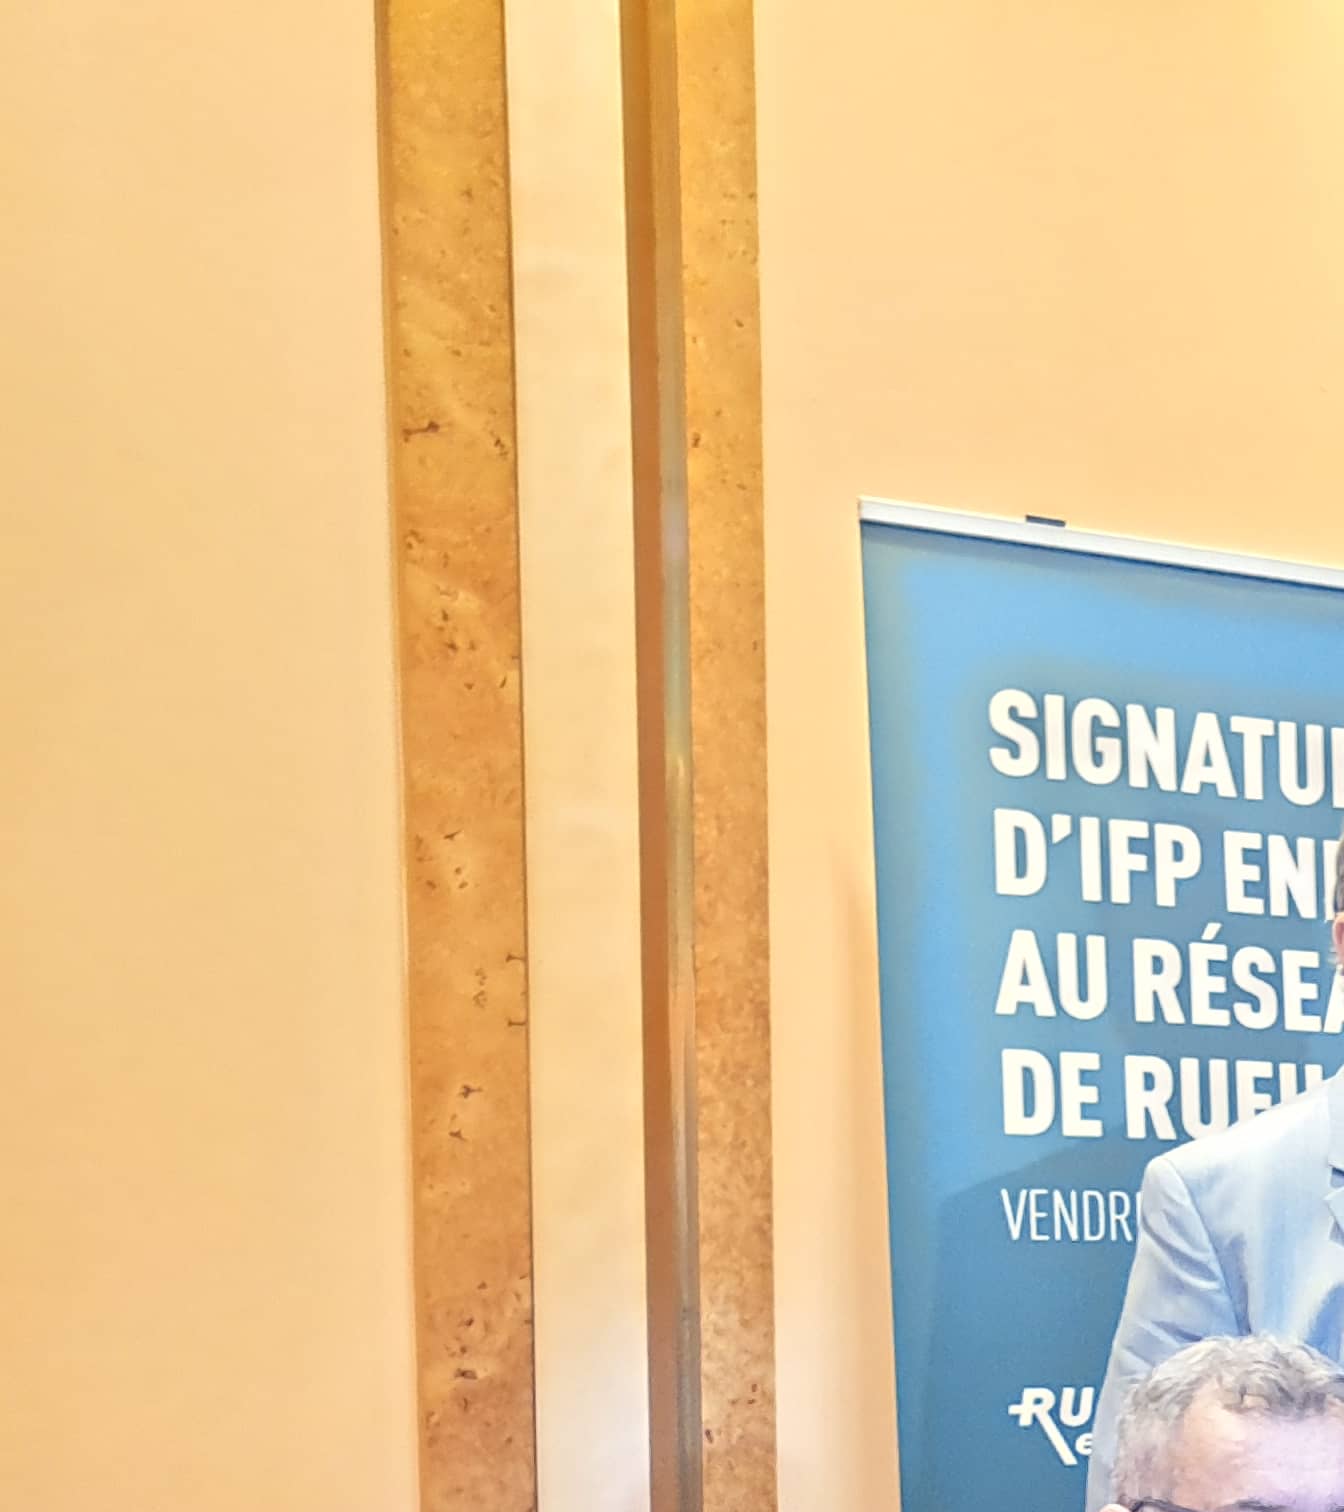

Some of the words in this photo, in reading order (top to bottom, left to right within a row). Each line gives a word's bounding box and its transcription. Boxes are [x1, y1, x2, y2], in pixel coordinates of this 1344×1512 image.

[994, 808, 1201, 907] D'IFP
[995, 930, 1107, 1019] AU
[1001, 1049, 1103, 1137] DE
